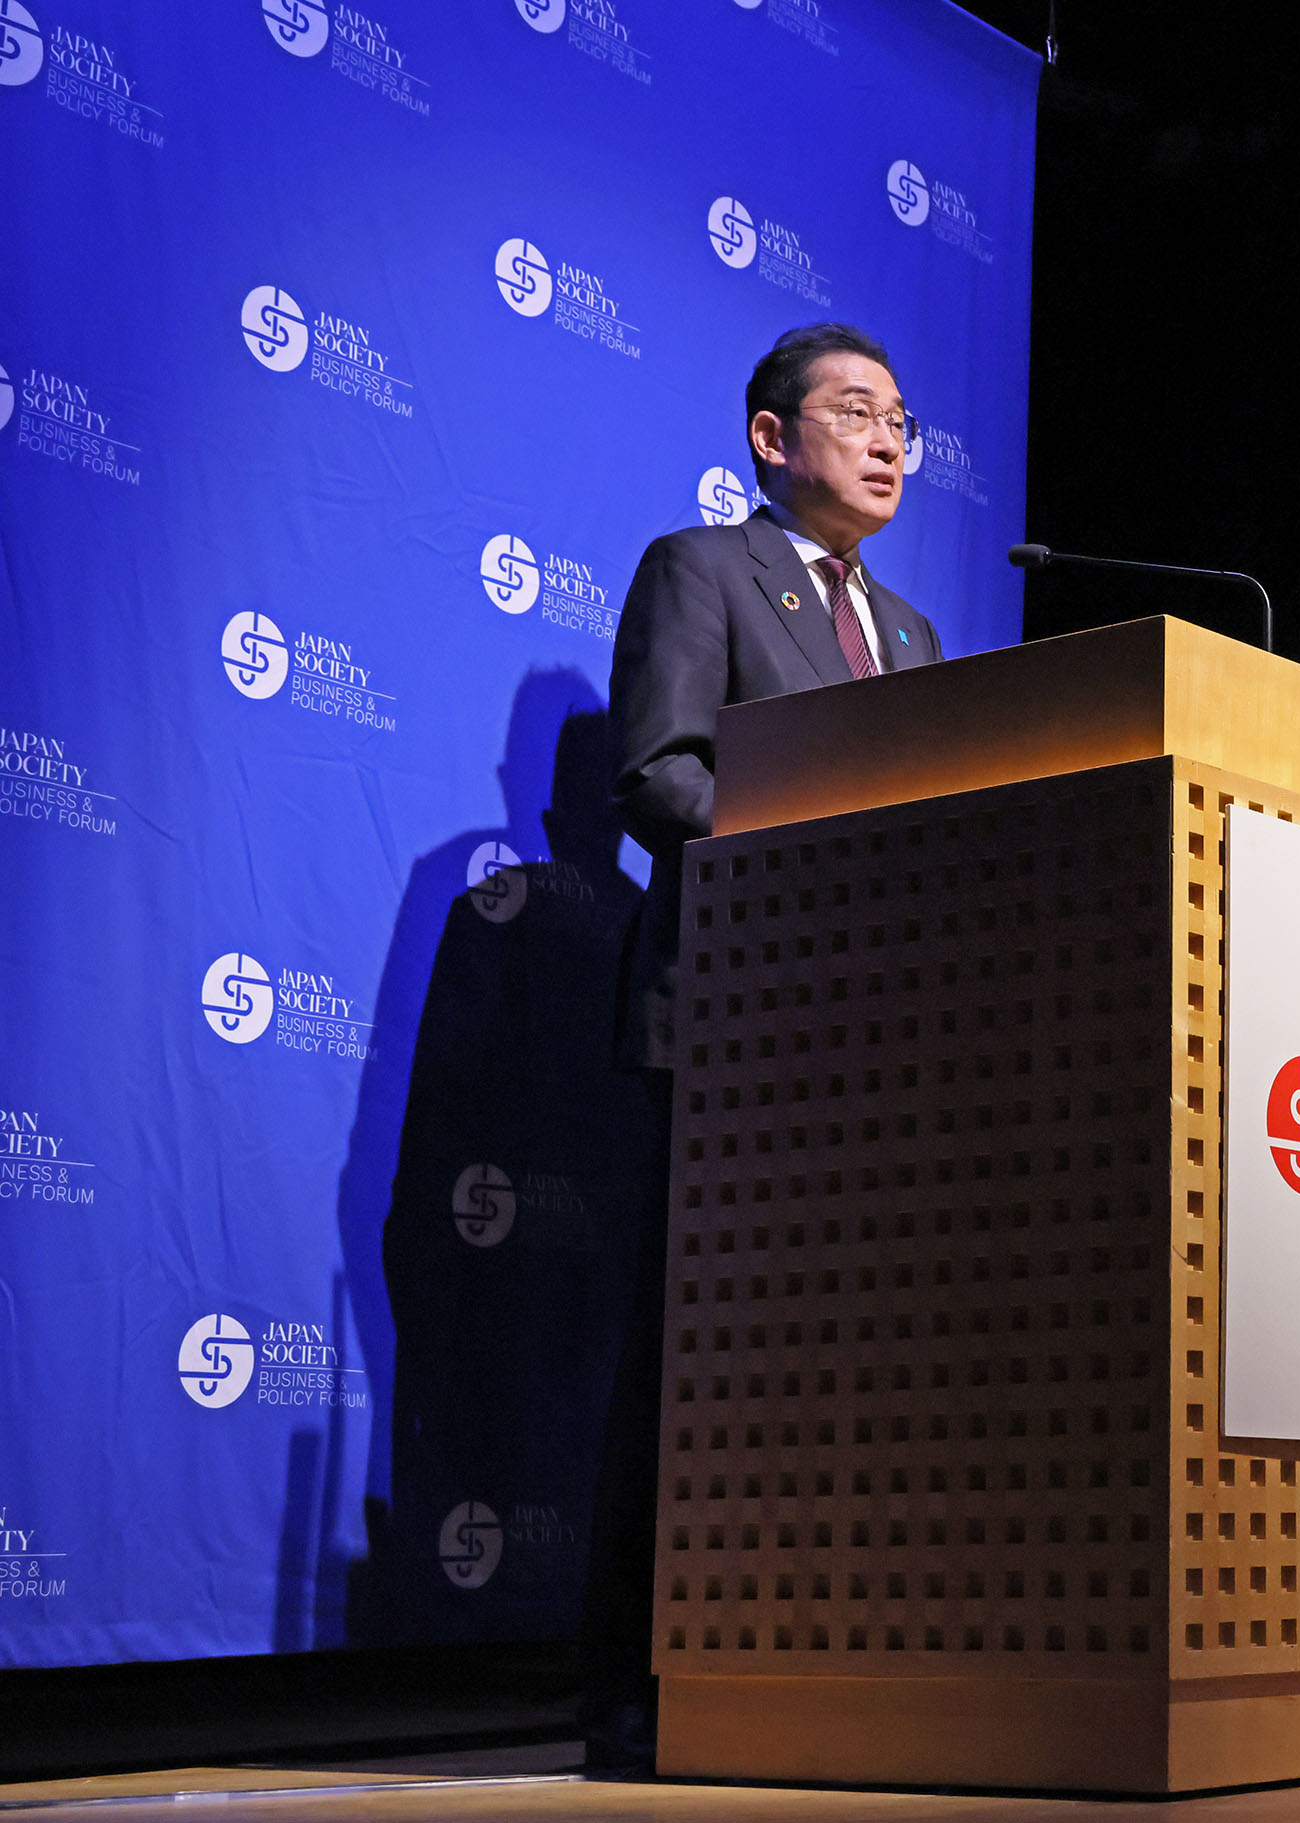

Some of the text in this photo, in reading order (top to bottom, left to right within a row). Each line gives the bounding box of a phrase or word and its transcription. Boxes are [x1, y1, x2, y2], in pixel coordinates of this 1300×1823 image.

[334, 4, 388, 42] JAPAN
[50, 26, 115, 68] JAPAN
[334, 20, 407, 68] SOCIETY
[50, 43, 137, 97] SOCIETY
[48, 68, 142, 124] BUSINESS &
[46, 84, 165, 149] POLICY FORUM
[760, 218, 800, 248] JAPAN
[760, 233, 815, 269] SOCIETY
[557, 262, 604, 293] JAPAN
[556, 277, 620, 317] SOCIETY
[314, 312, 370, 346] JAPAN
[554, 313, 641, 360] POLICY FORUM
[555, 299, 624, 339] BUSINESS &
[314, 328, 389, 372] SOCIETY
[23, 369, 88, 406] JAPAN
[312, 352, 393, 396] BUSINESS &
[311, 367, 413, 418] POLICY FORUM
[22, 388, 111, 434] SOCIETY
[20, 414, 117, 461] BUSINESS &
[925, 425, 963, 449] JAPAN
[18, 432, 140, 486] POLICY FORUM
[925, 440, 973, 470] SOCIETY
[544, 553, 592, 582] JAPAN
[544, 570, 609, 605] SOCIETY
[542, 607, 616, 642] POLICY FOR
[543, 592, 614, 627] BUSINESS &
[294, 631, 351, 662] JAPAN
[294, 650, 372, 687] SOCIETY
[292, 675, 376, 711] BUSINESS &
[291, 691, 396, 732] POLICY FORUM
[0, 780, 94, 813] USINESS &
[0, 798, 116, 836] OLICY FORUM
[278, 967, 333, 994] JAPAN
[278, 987, 355, 1018] SOCIETY
[276, 1030, 322, 1053] POLICY
[277, 1014, 359, 1042] BUSINESS &
[58, 1167, 69, 1184] &
[32, 1184, 95, 1204] FORUM
[262, 1322, 324, 1343] JAPAN
[261, 1343, 341, 1366] SOCIETY
[259, 1371, 336, 1390] BUSINESS
[257, 1389, 367, 1409] POLICY FORUM
[28, 1561, 40, 1577] &
[0, 1580, 66, 1598] FORUM
